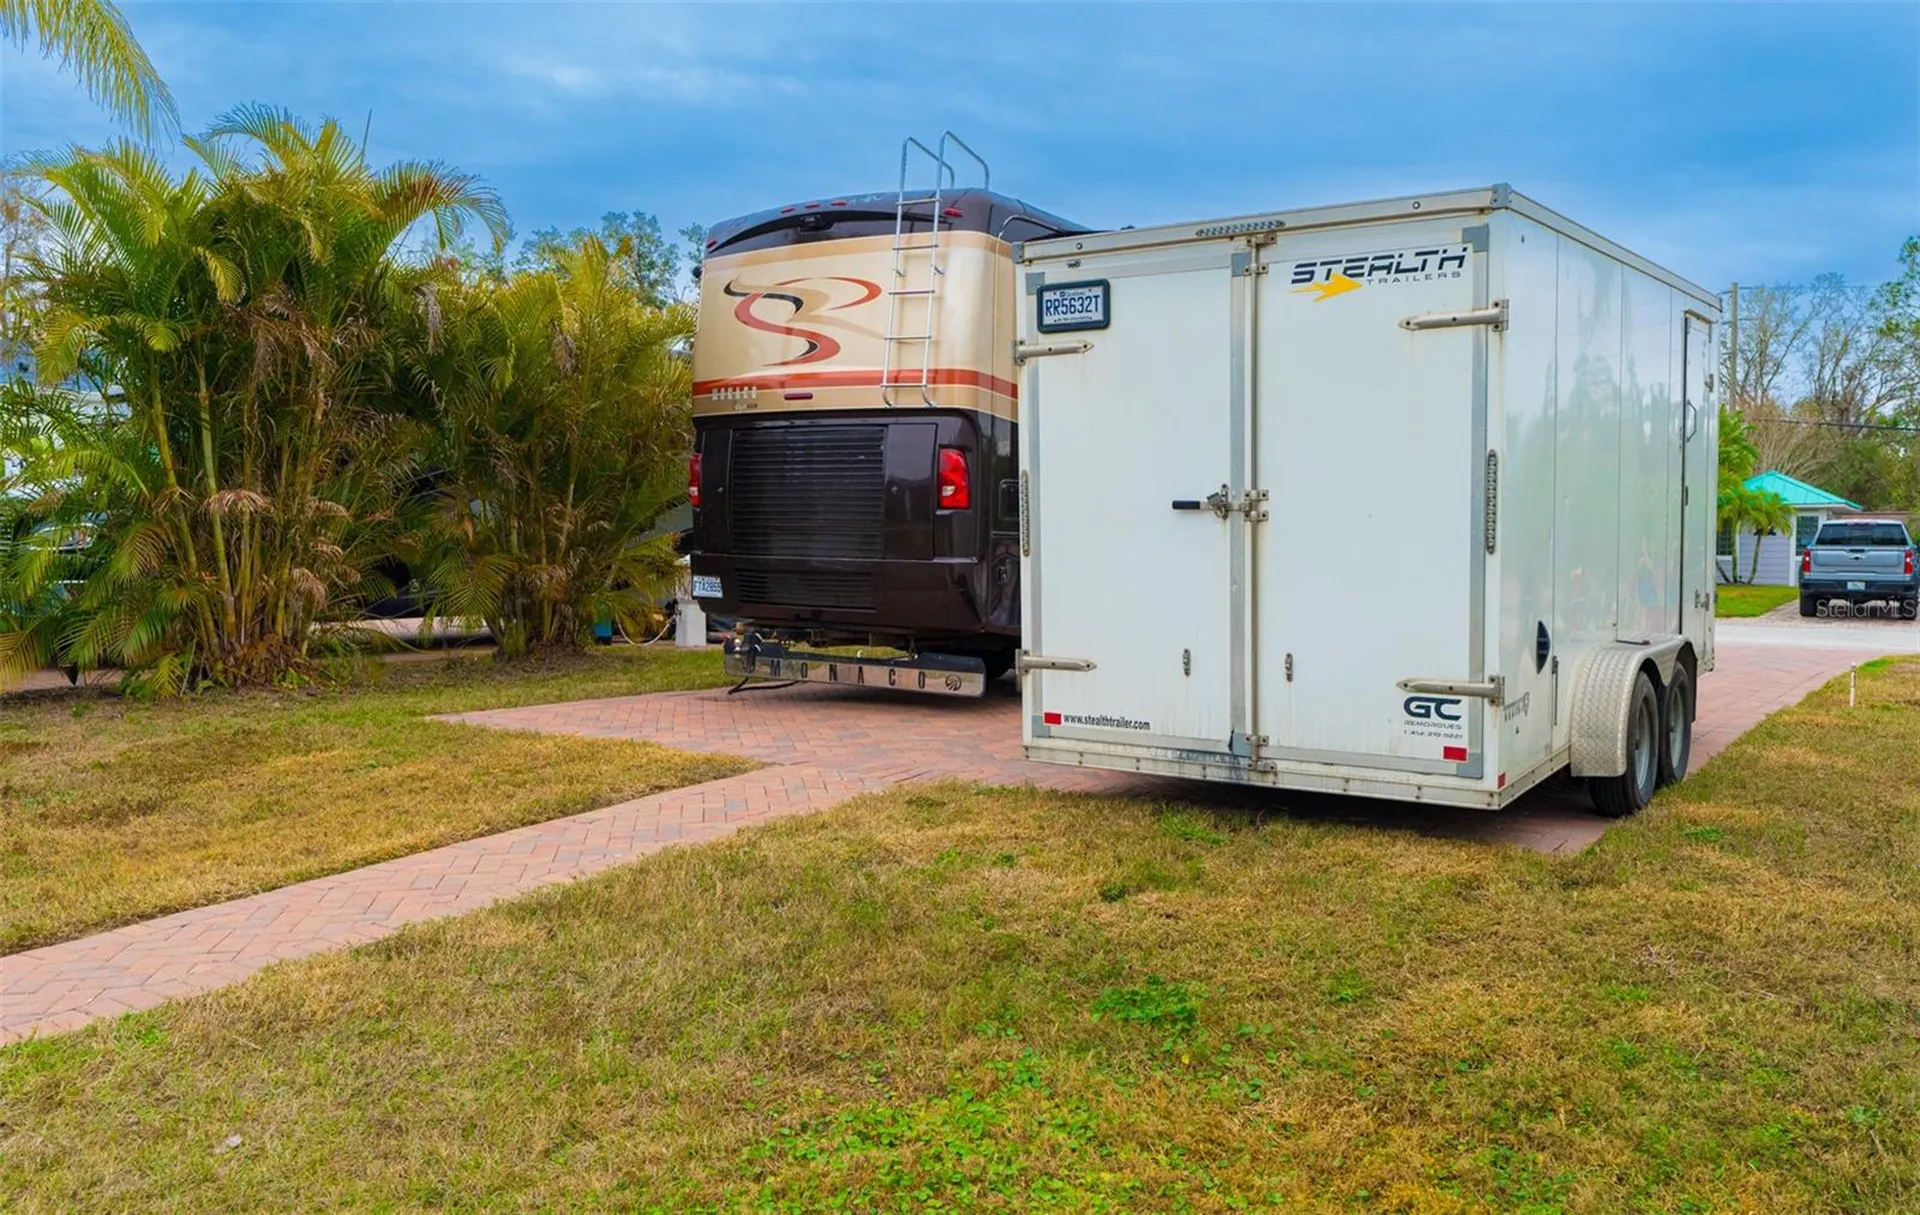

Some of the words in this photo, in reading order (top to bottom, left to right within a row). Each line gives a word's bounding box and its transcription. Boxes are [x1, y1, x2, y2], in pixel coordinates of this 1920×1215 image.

[1291, 247, 1467, 284] STEALTH
[1366, 271, 1462, 286] TRAILERS
[1045, 295, 1101, 317] RR5632T
[770, 660, 925, 688] MONACO
[1403, 696, 1462, 721] GC
[1064, 715, 1150, 730] www.stealthtrailer.com
